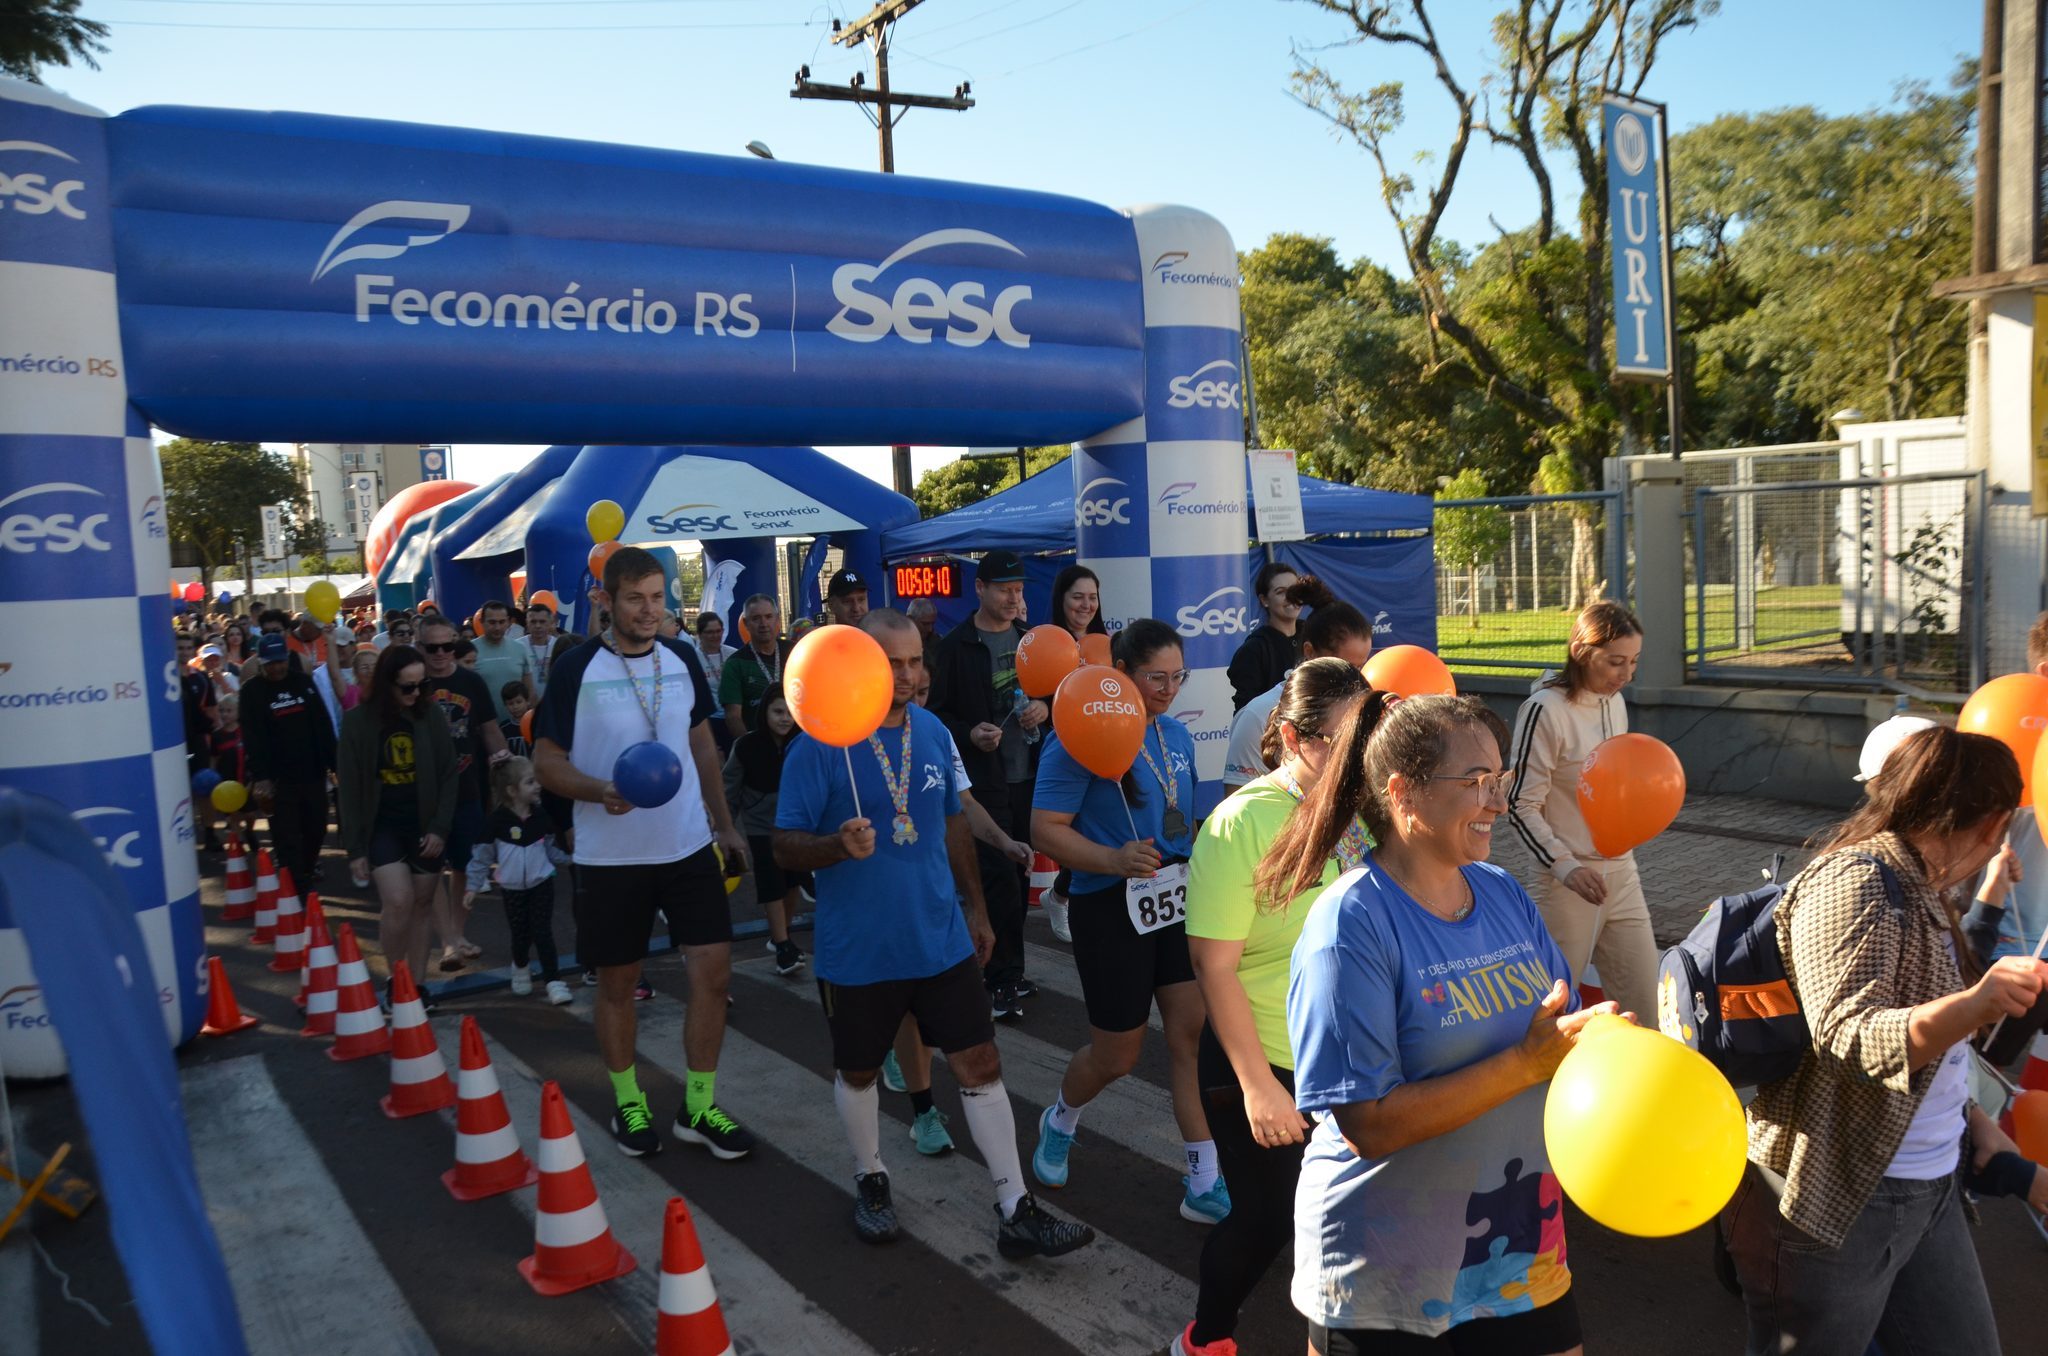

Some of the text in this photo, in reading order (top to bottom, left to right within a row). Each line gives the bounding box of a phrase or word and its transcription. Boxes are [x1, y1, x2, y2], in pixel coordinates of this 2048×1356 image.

[1161, 270, 1232, 288] Fecomércio
[1620, 187, 1652, 364] URI
[355, 274, 760, 338] Fecomércio RS
[87, 357, 117, 377] RS
[743, 505, 821, 520] Fecomércio
[1167, 499, 1240, 516] Fecomércio
[896, 565, 951, 597] 00:58:10
[114, 681, 142, 700] RS
[1083, 701, 1139, 717] CRESOL
[1138, 884, 1188, 928] 853
[1465, 957, 1481, 968] EM
[1440, 957, 1555, 1029] AO AUTISM
